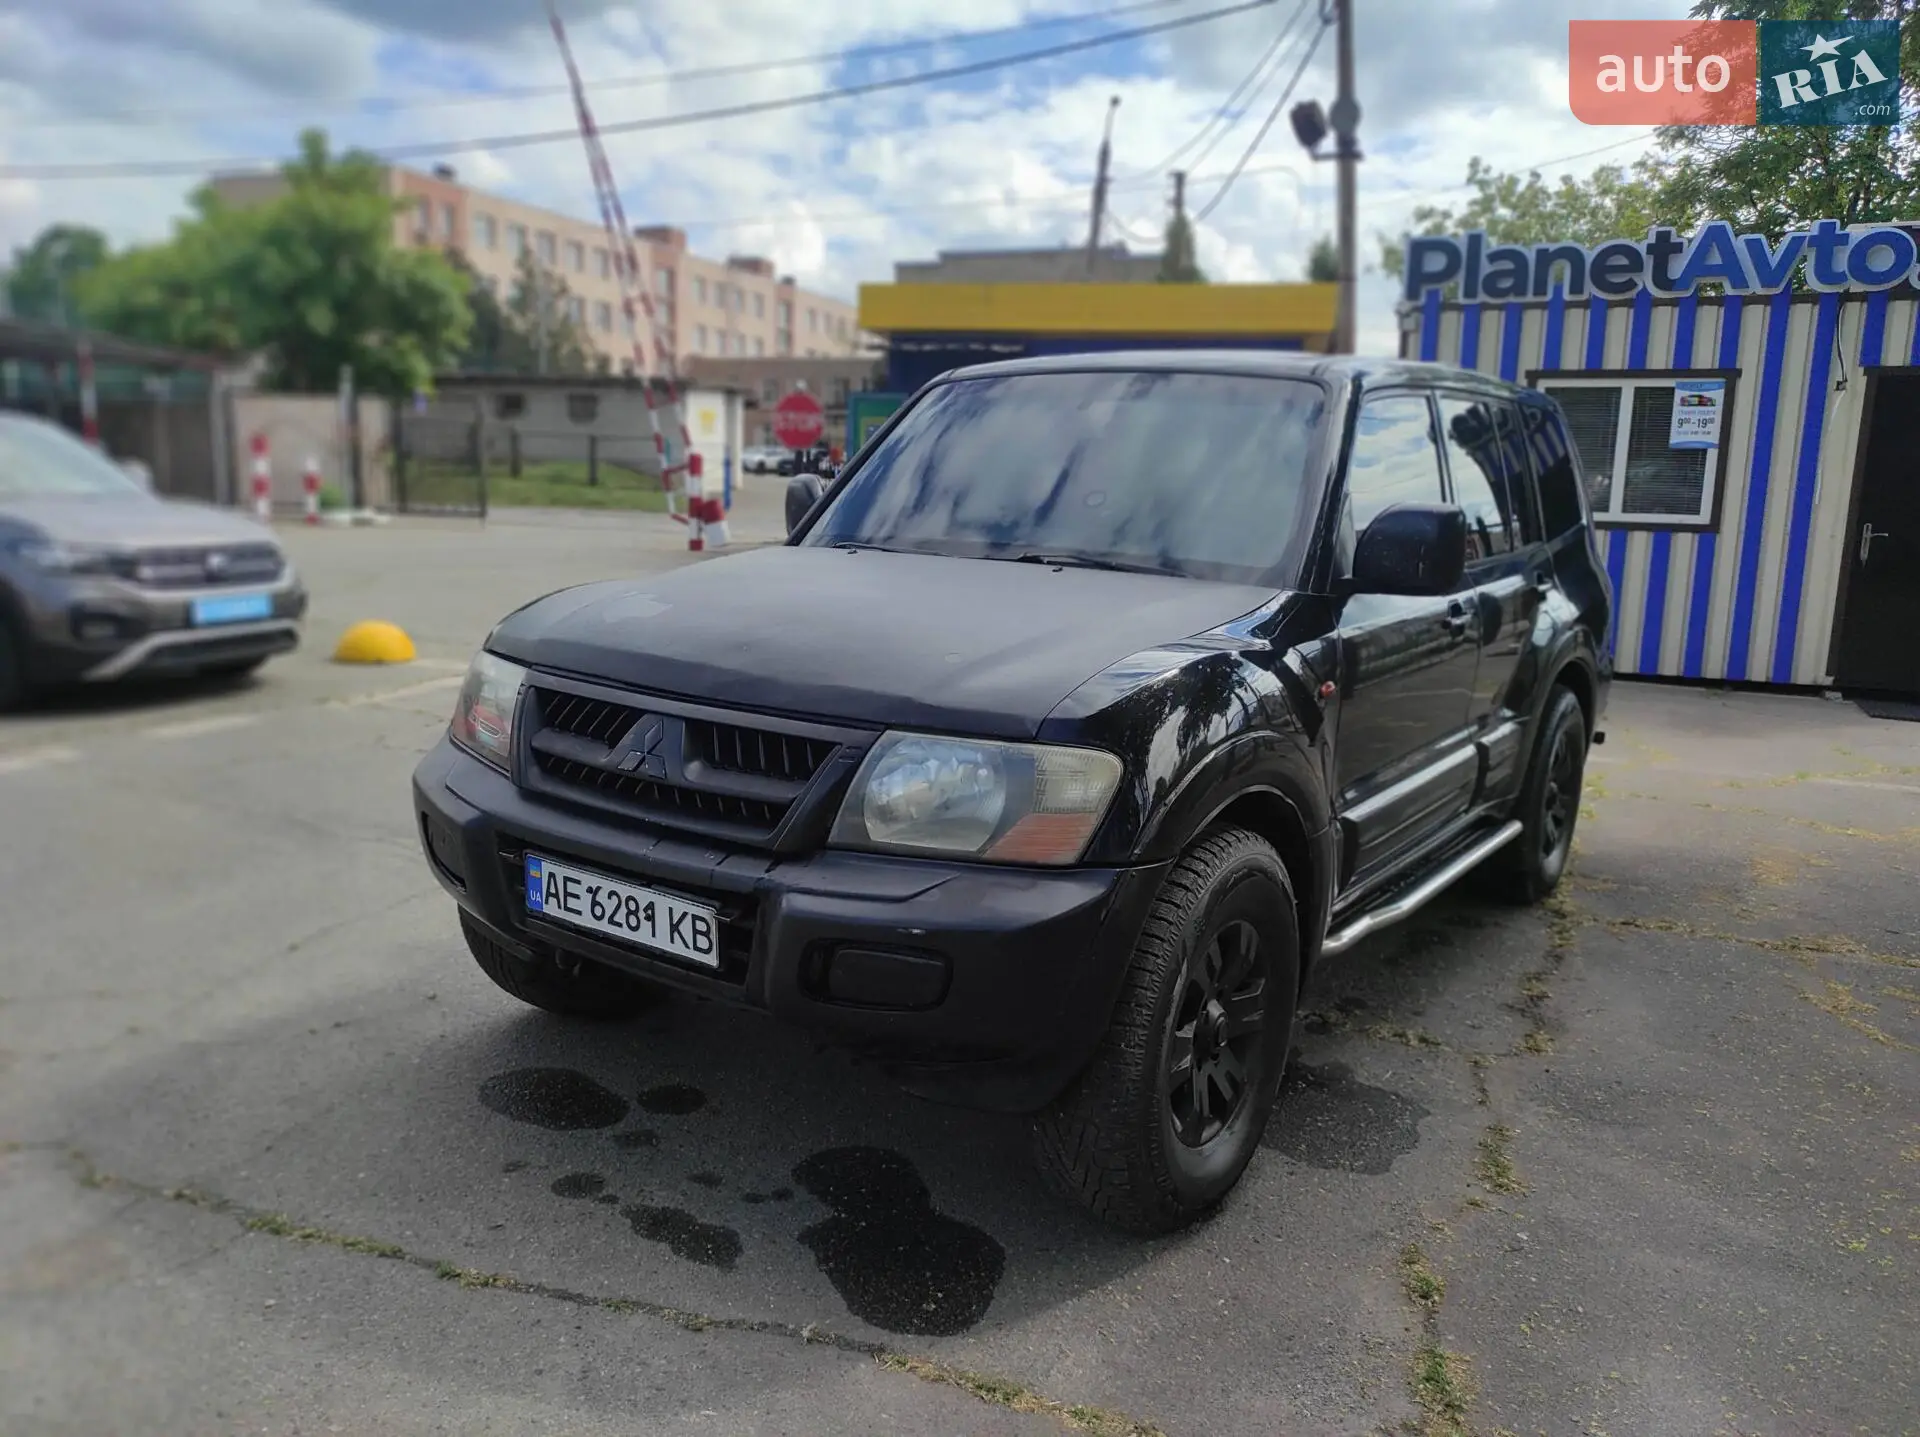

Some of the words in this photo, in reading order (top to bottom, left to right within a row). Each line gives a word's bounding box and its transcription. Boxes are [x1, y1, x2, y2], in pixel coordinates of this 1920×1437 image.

[1405, 221, 1920, 300] PlanetAvto
[530, 889, 542, 902] UA
[544, 871, 583, 917] AE
[586, 885, 657, 938] 6281
[668, 906, 714, 955] KB
